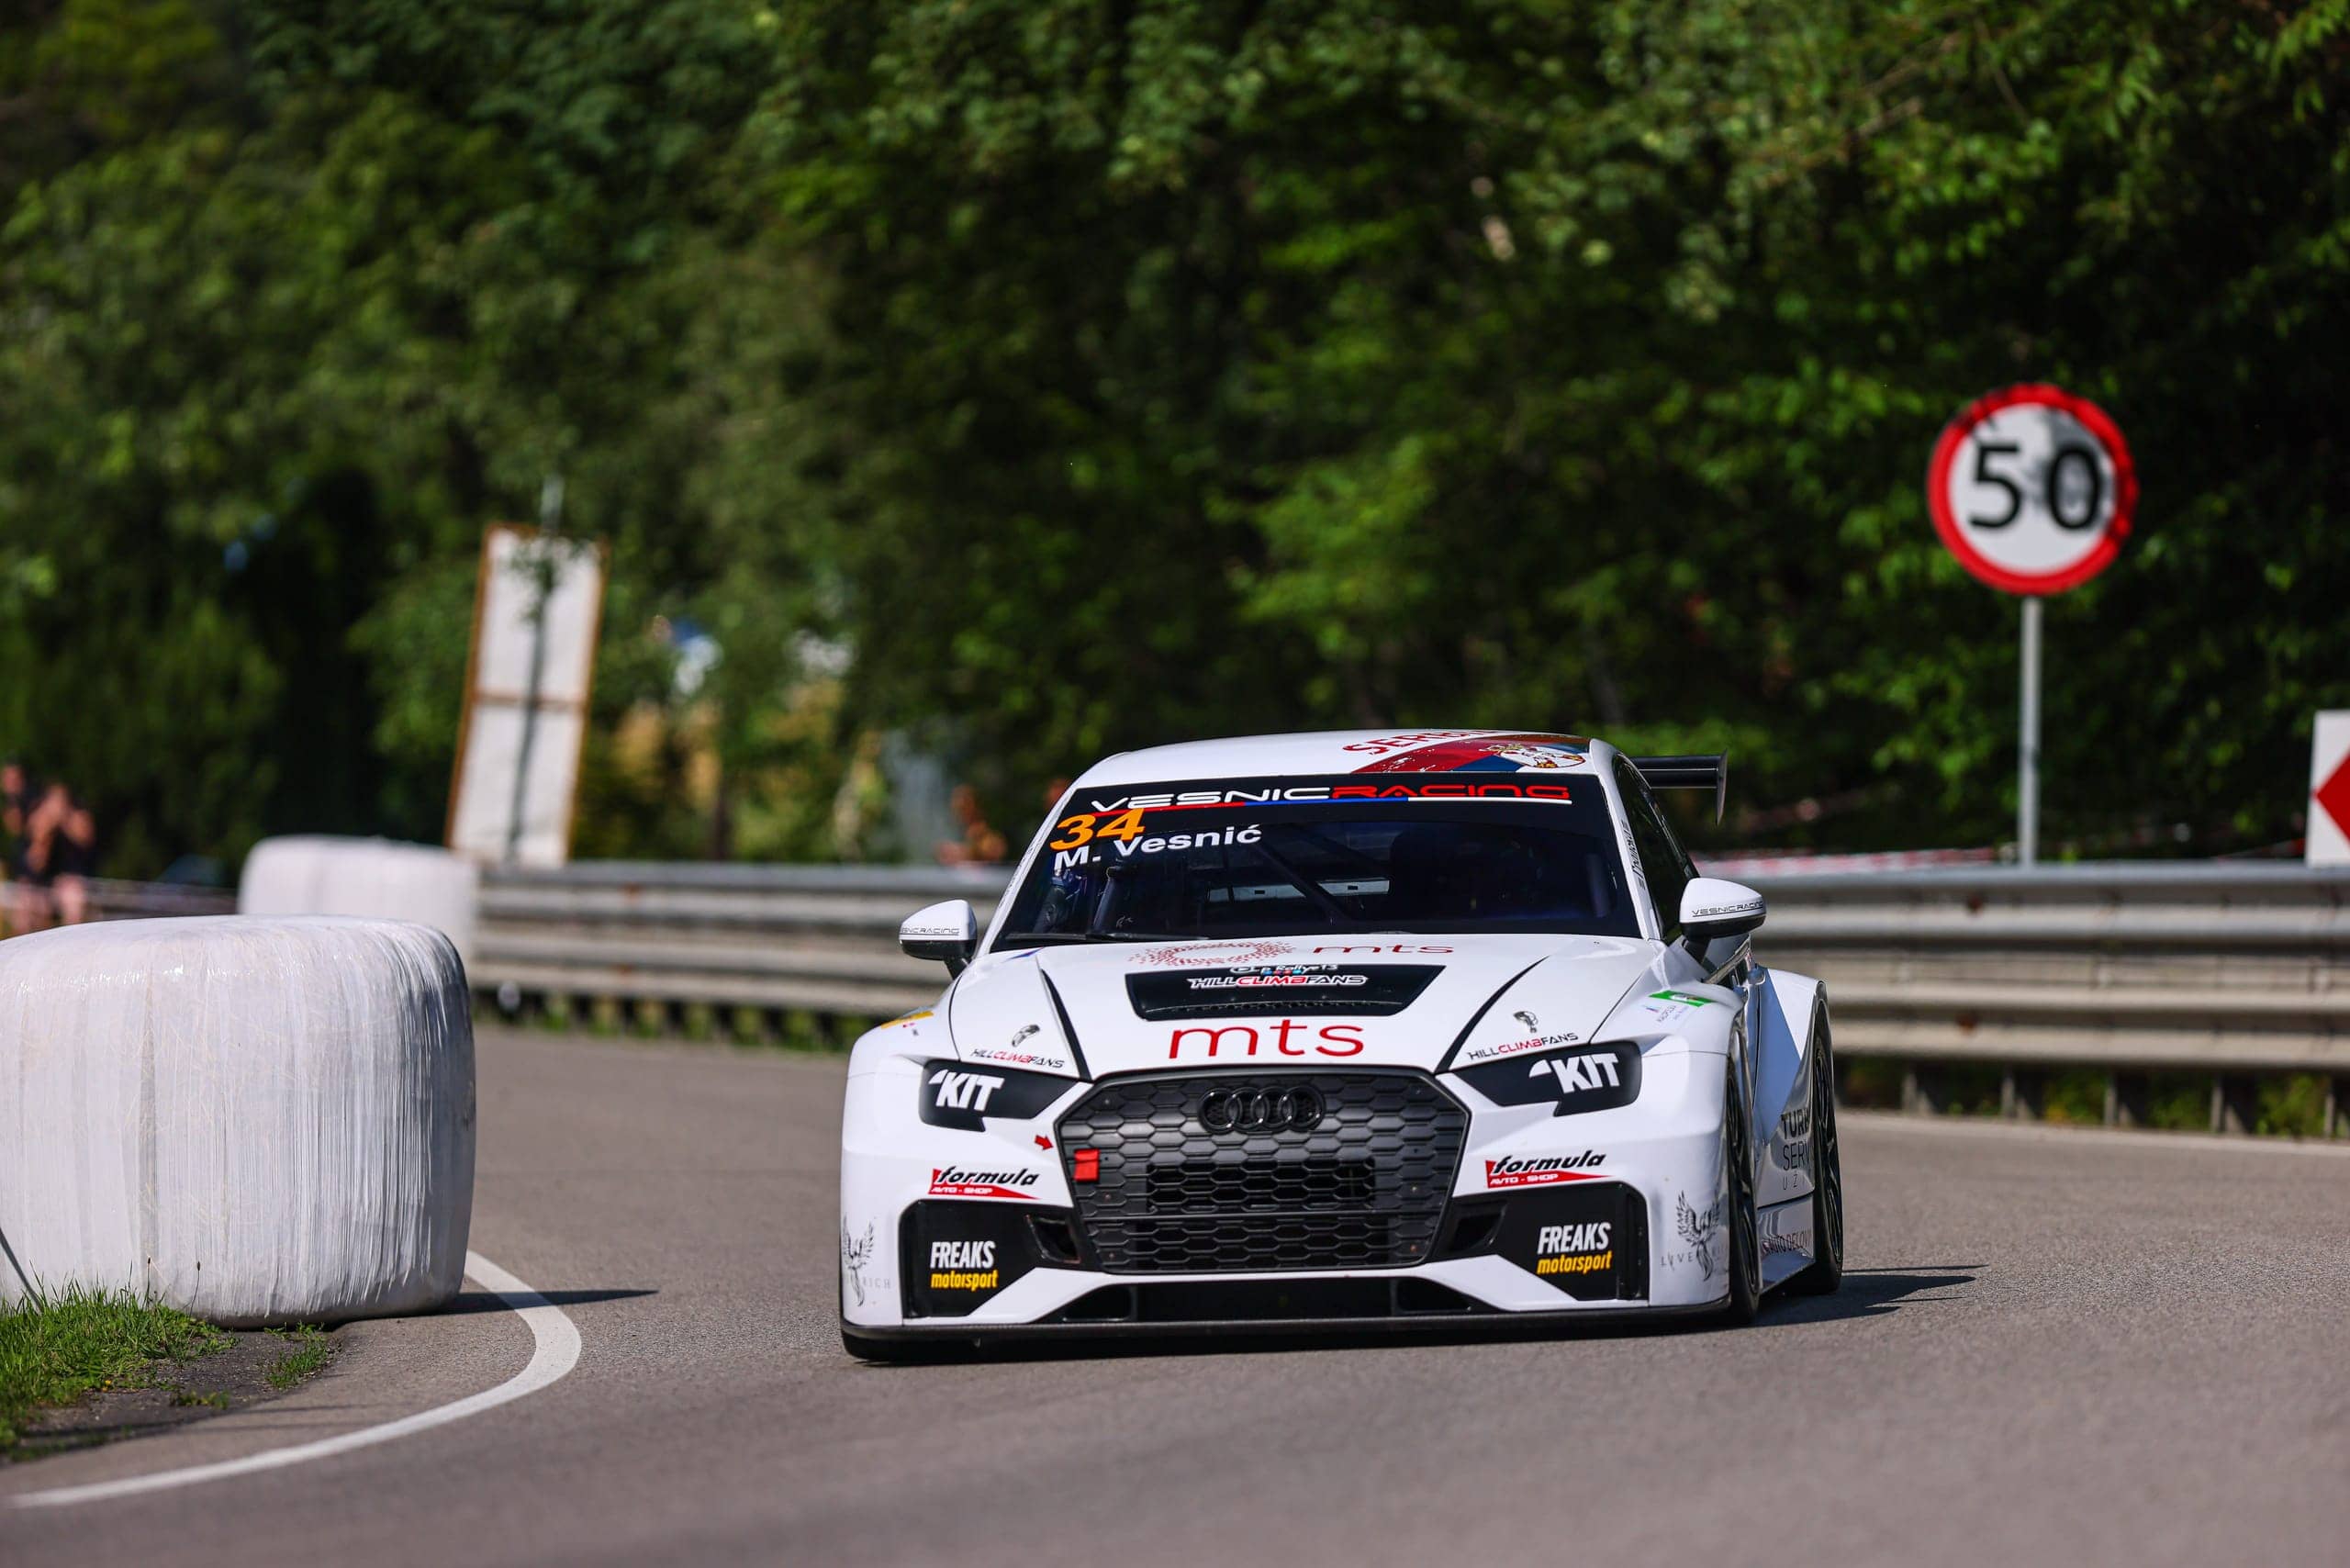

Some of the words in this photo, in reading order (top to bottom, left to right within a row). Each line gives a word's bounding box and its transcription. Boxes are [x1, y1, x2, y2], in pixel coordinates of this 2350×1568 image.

[1970, 442, 2102, 530] 50
[1049, 808, 1147, 851] 34
[1053, 845, 1102, 872] M.
[1113, 823, 1263, 857] Vesnić
[1313, 944, 1455, 955] mts
[1168, 1019, 1364, 1059] mts
[1550, 1053, 1619, 1094] KIT
[935, 1070, 1005, 1112] KIT
[937, 1166, 1040, 1186] formula
[1493, 1150, 1606, 1175] formula
[930, 1240, 996, 1269] FREAKS
[1537, 1222, 1612, 1255] FREAKS
[1537, 1250, 1613, 1275] motorsport
[931, 1270, 999, 1292] motorsport
